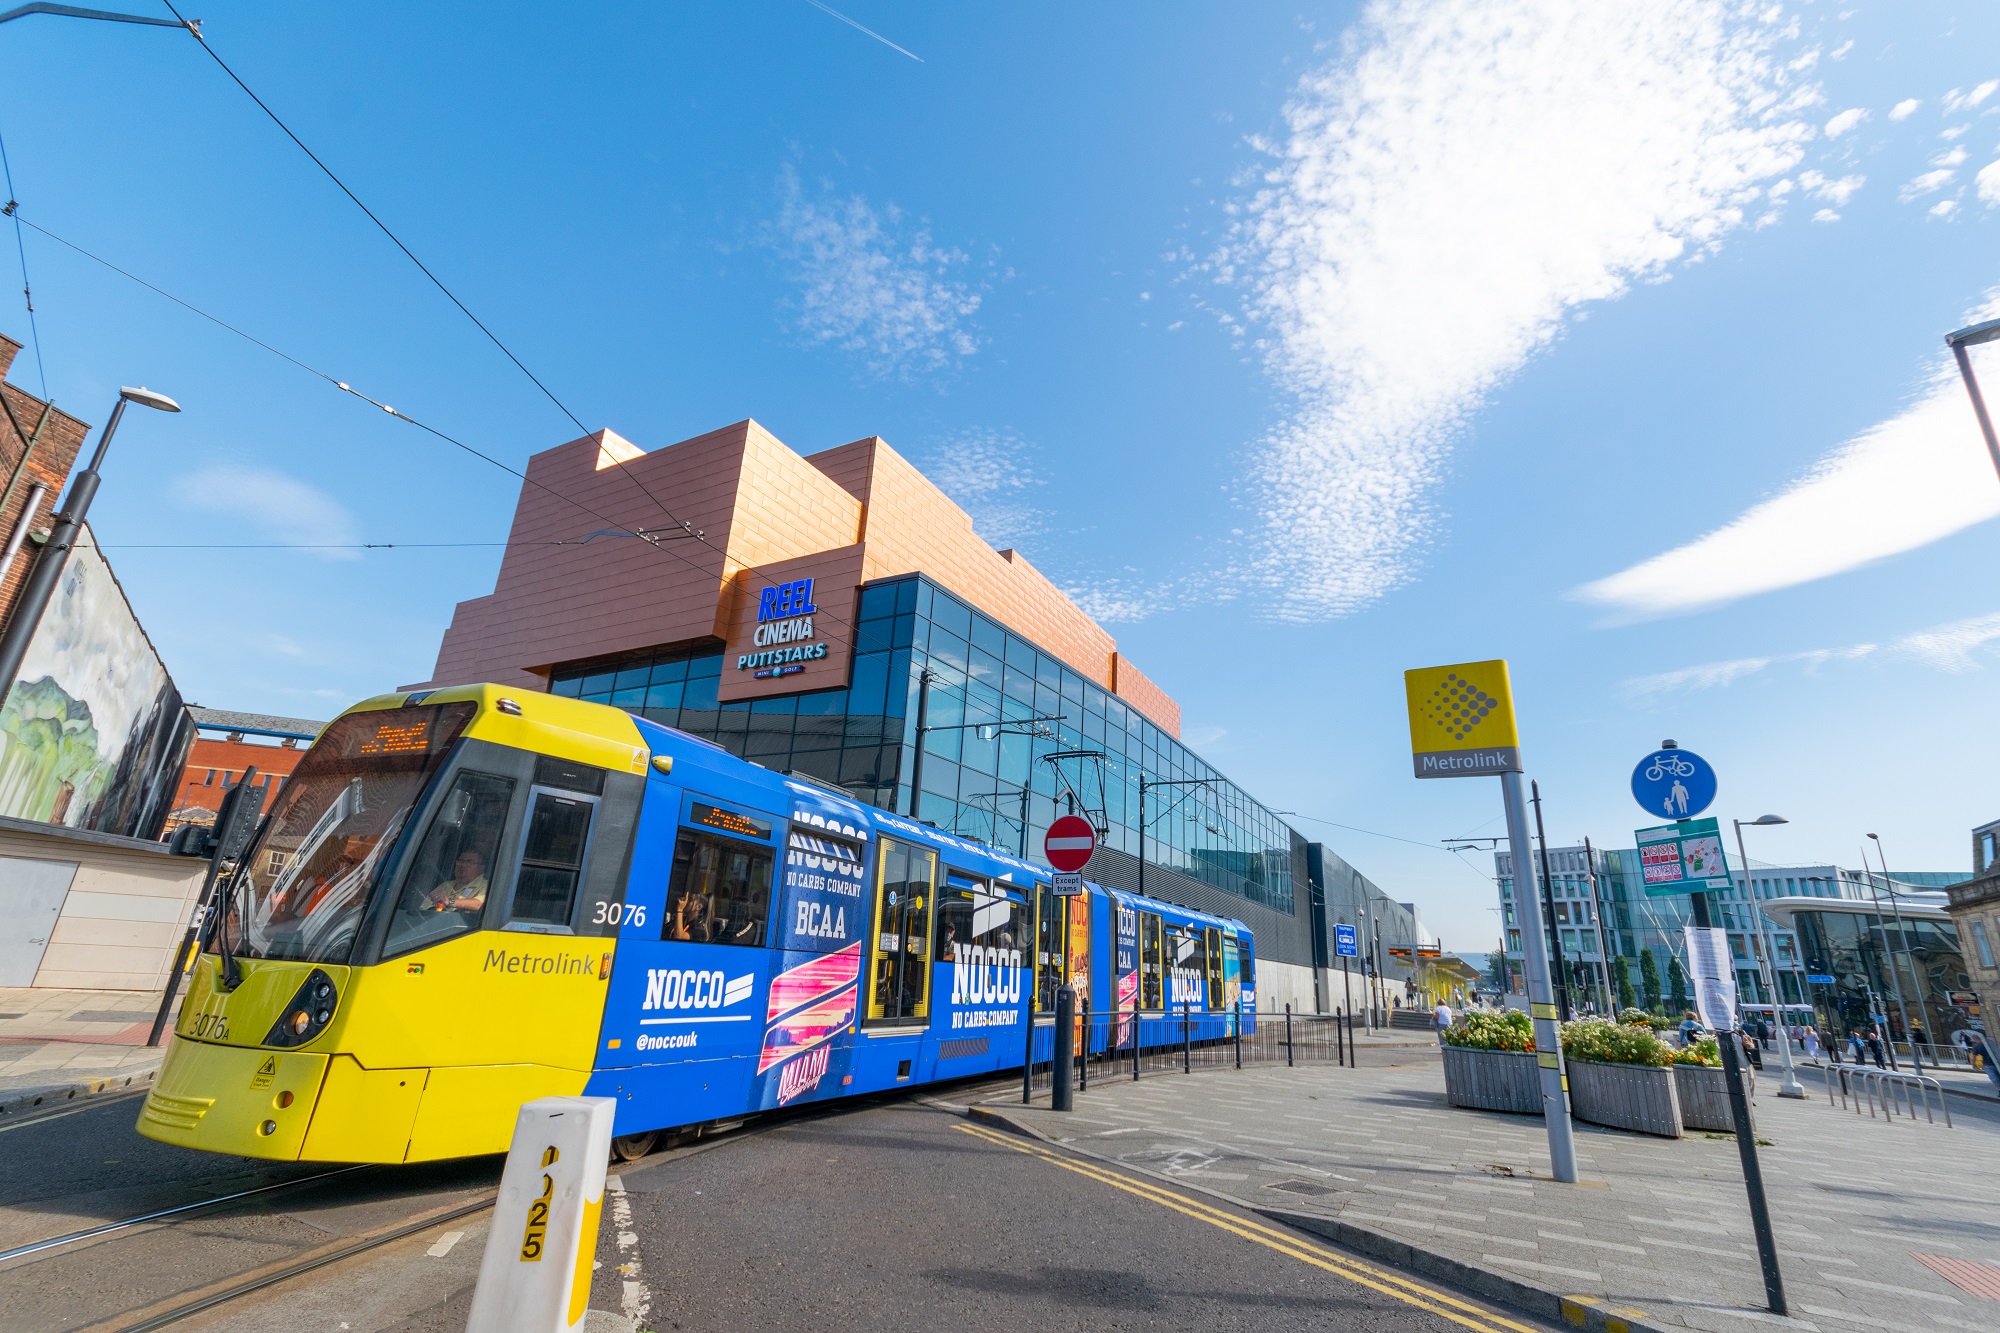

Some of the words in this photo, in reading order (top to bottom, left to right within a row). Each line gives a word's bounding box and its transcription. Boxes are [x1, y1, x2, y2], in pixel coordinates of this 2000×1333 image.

[757, 577, 818, 623] REEL
[753, 616, 815, 647] CINEMA
[737, 642, 829, 671] PUTTSTARS
[1423, 751, 1508, 771] Metrolink
[786, 871, 796, 887] NO
[798, 875, 825, 891] CARBS
[827, 878, 862, 898] COMPANY
[1055, 876, 1079, 885] Except
[591, 901, 647, 928] 3076
[794, 900, 846, 939] BCAA
[482, 949, 595, 975] Metrolink
[951, 942, 1021, 1005] NOCCO
[642, 969, 725, 1010] NOCCO
[1170, 966, 1202, 1003] NOCCO
[189, 1012, 231, 1041] 3076A
[951, 1011, 963, 1029] NO
[964, 1009, 988, 1028] CARBS
[988, 1009, 1019, 1026] COMPANY
[636, 1031, 698, 1051] @noccouk
[776, 1043, 832, 1100] MIAMI
